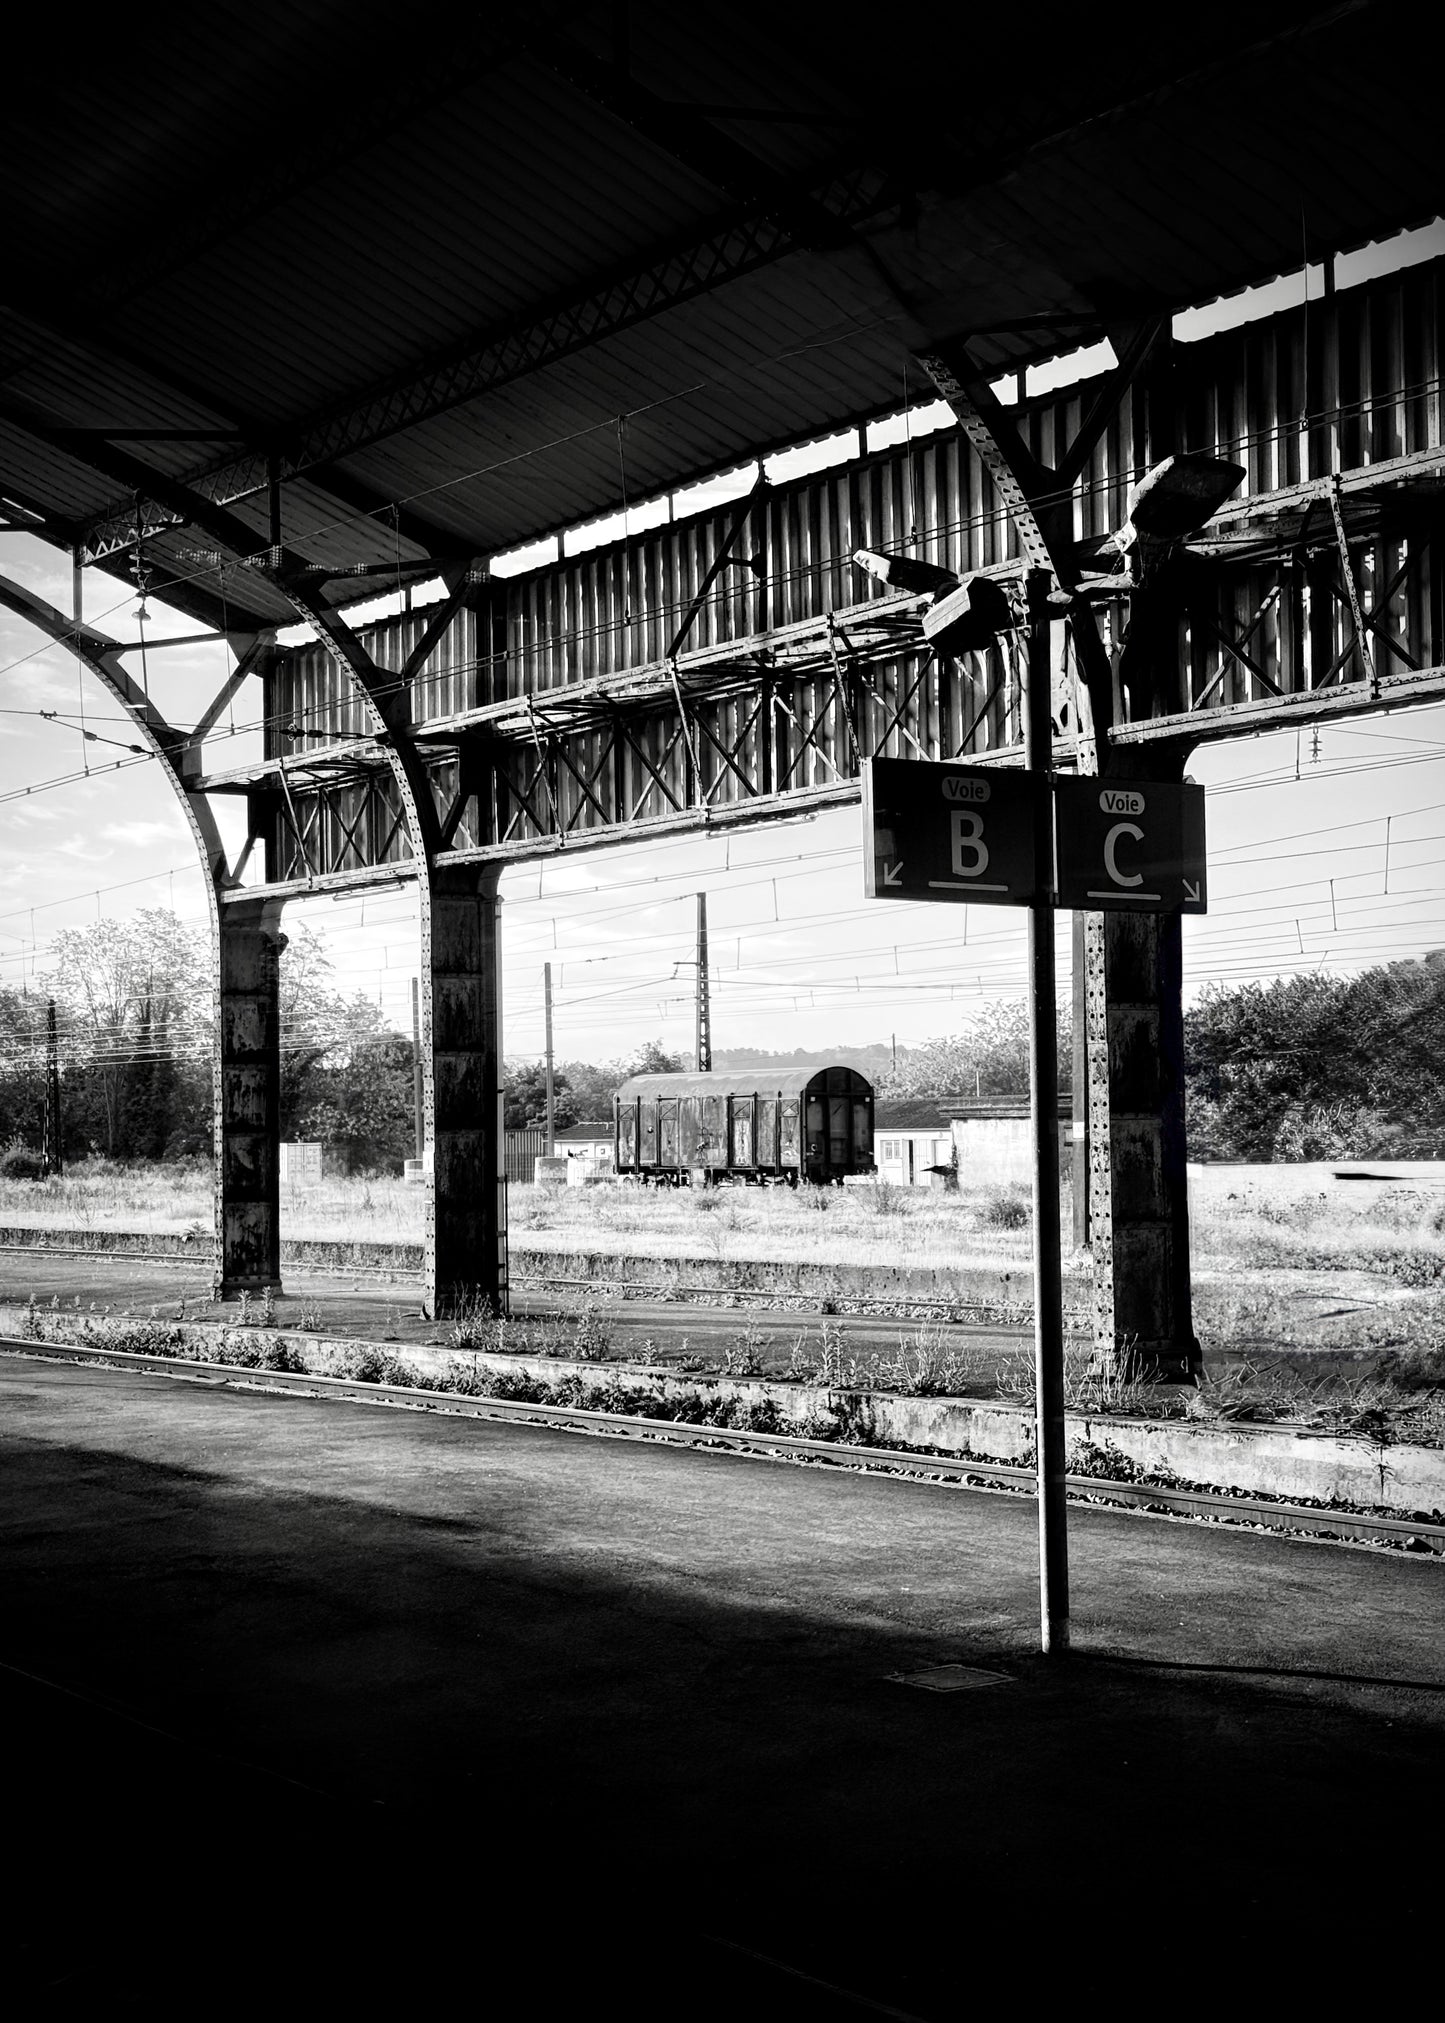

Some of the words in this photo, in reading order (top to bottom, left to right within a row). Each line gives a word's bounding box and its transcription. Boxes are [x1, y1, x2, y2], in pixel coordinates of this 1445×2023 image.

[948, 780, 984, 799] Voie
[1105, 794, 1139, 812] Voie
[950, 810, 989, 877] B
[1103, 822, 1145, 887] C
